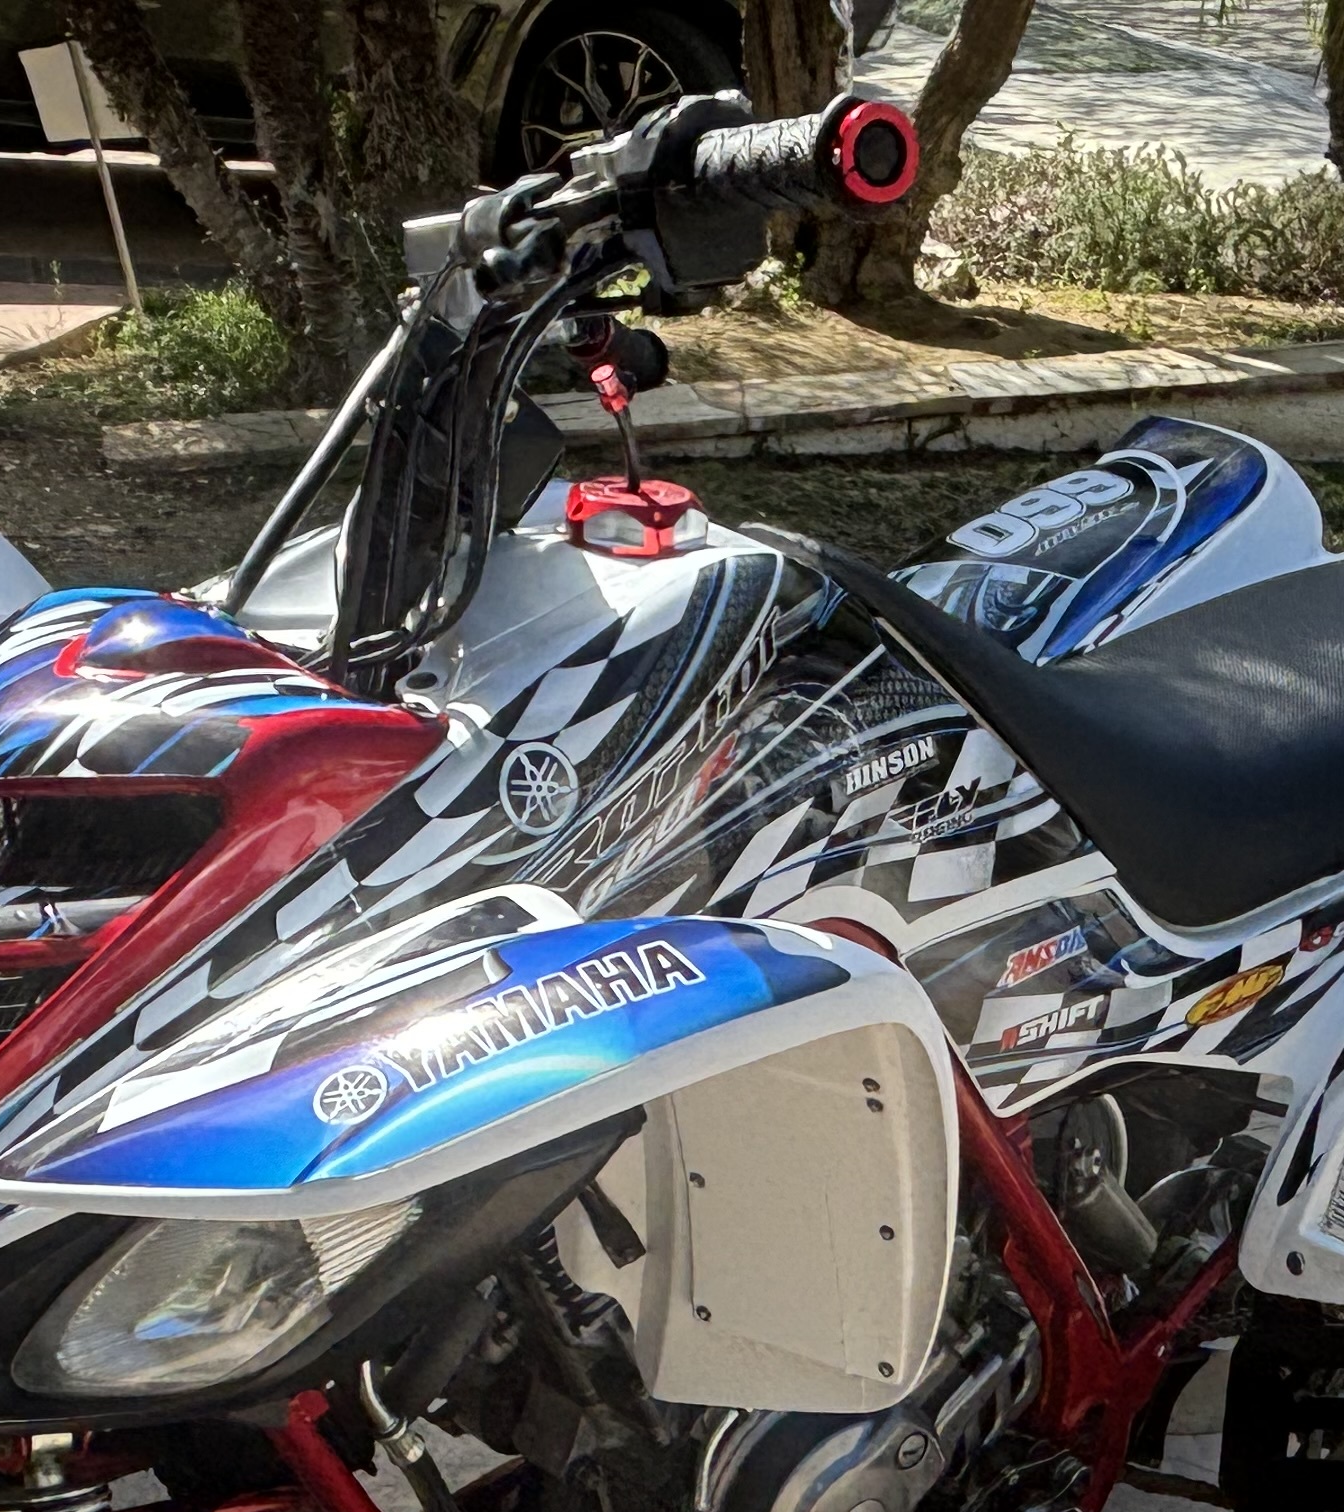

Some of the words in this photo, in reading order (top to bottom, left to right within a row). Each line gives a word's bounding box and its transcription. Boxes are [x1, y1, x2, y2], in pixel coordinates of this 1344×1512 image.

[845, 735, 937, 796] HINSON
[889, 776, 982, 833] FLY
[372, 940, 707, 1093] YAMAHA
[1015, 994, 1105, 1046] SHIFT
